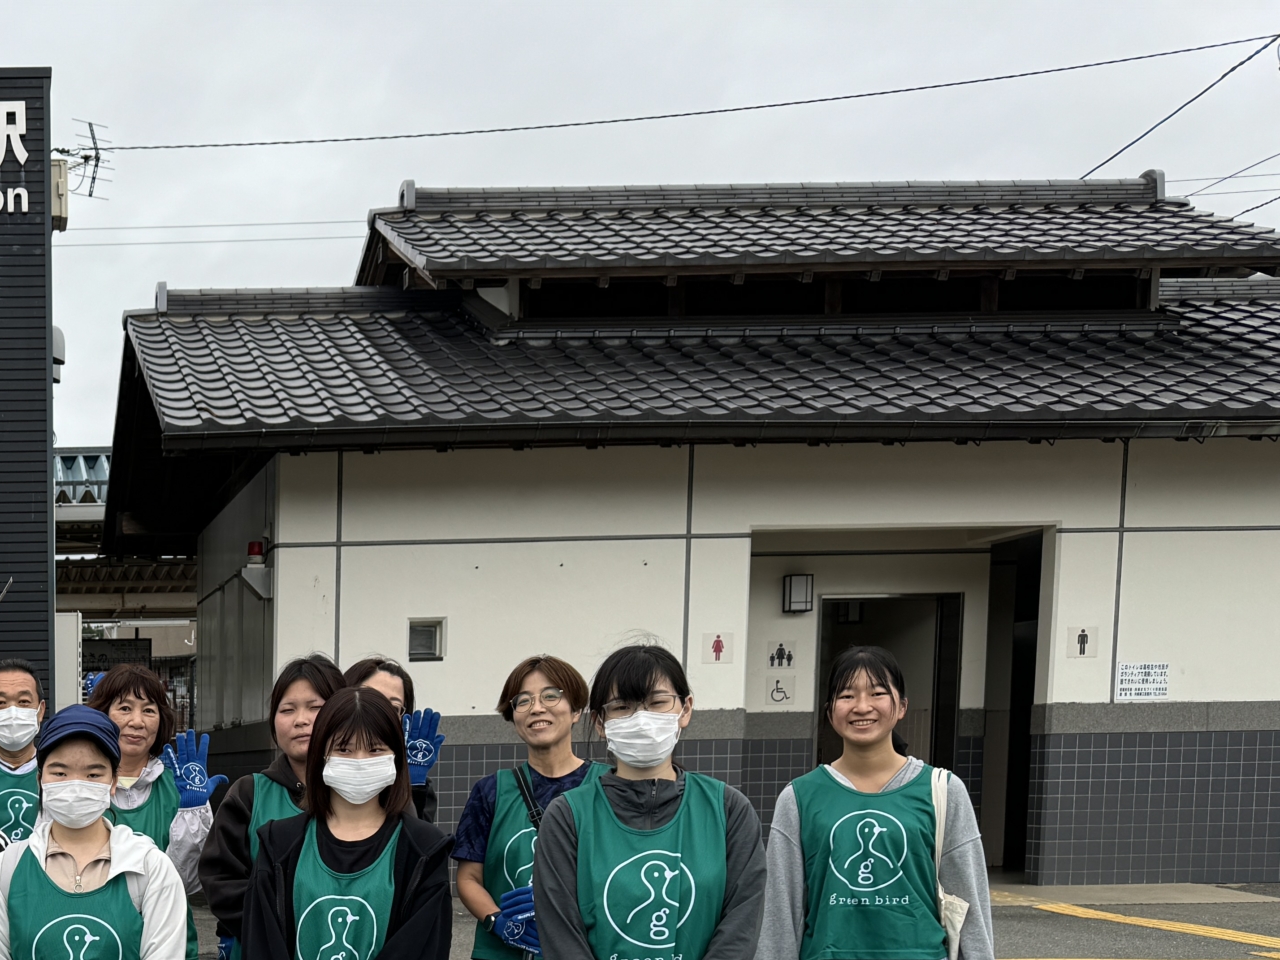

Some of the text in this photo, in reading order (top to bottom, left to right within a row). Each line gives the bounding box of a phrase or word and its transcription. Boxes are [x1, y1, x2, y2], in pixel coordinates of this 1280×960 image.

[858, 858, 874, 884] g
[875, 895, 909, 905] bird
[650, 908, 670, 939] g
